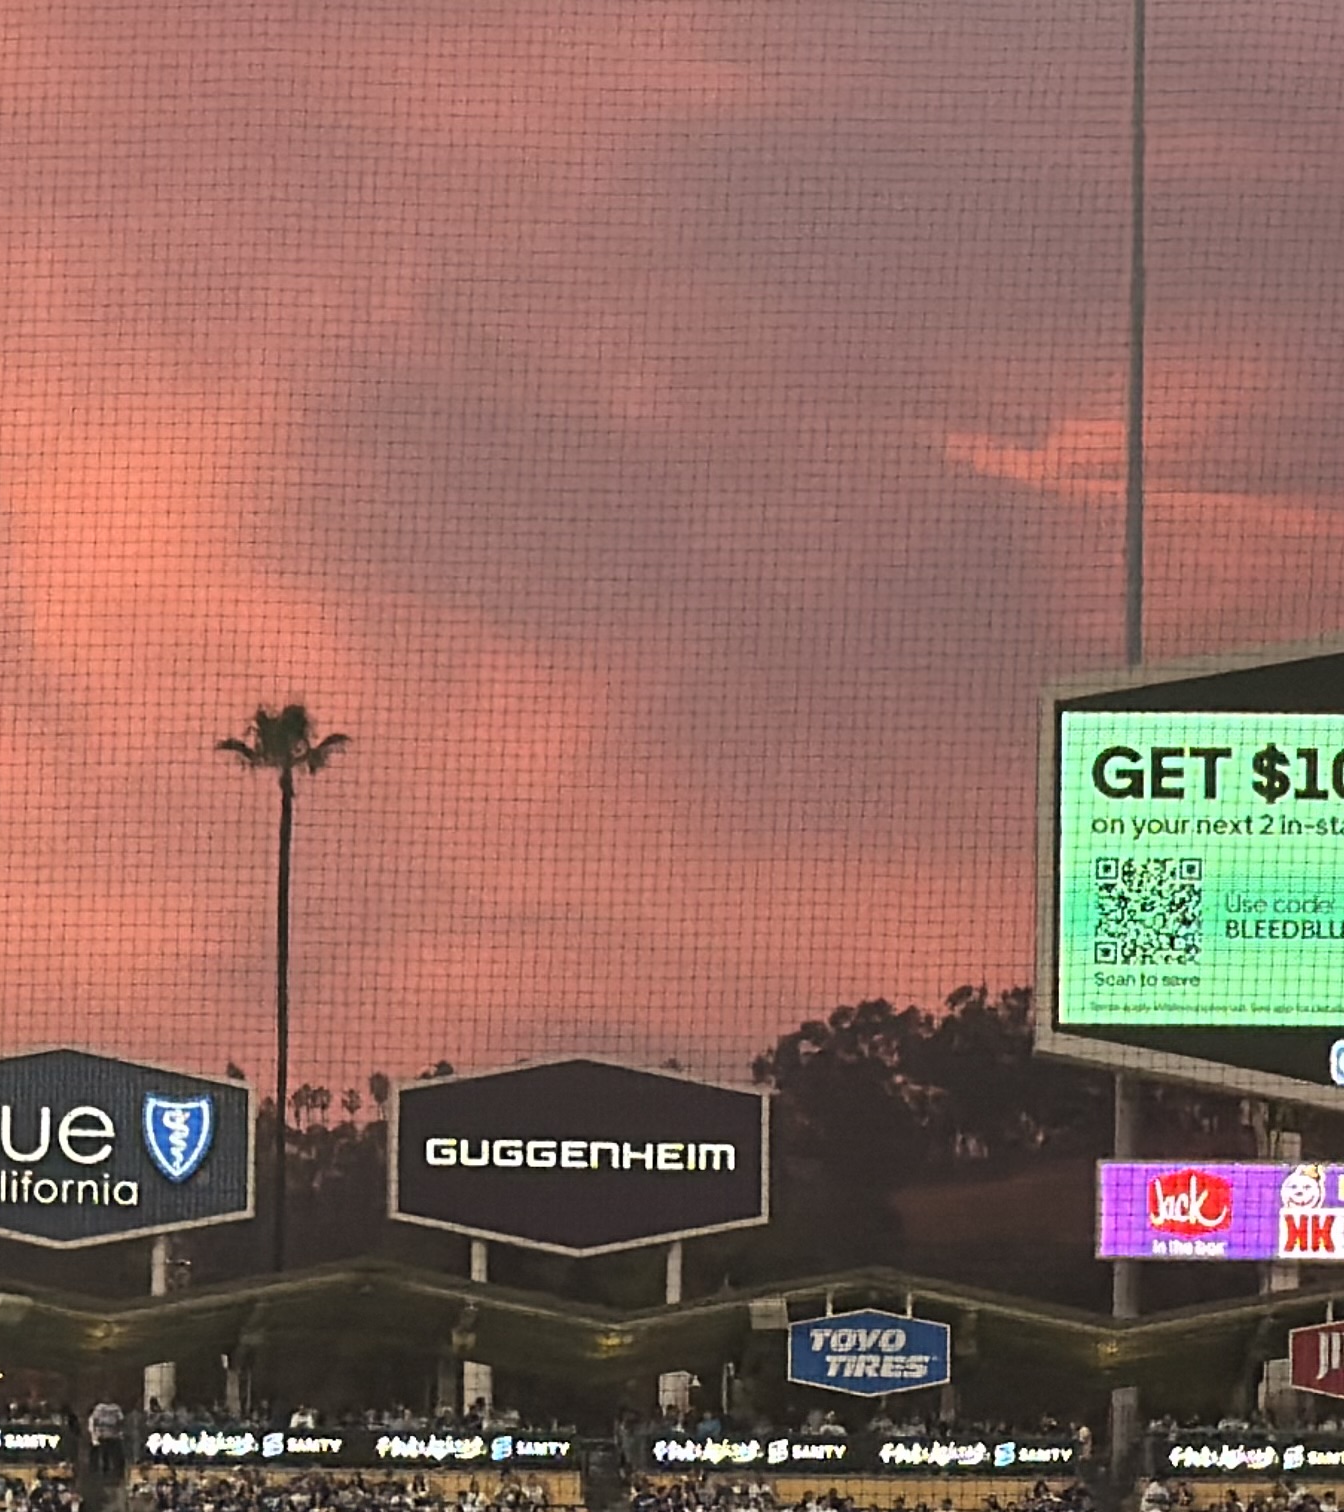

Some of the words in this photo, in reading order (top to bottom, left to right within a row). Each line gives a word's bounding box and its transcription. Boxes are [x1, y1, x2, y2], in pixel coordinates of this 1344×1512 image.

[1093, 746, 1232, 801] GET
[1092, 817, 1125, 836] on
[1132, 818, 1186, 840] your
[1197, 815, 1254, 836] next
[1259, 814, 1274, 836] 2
[1225, 894, 1266, 914] Use
[1094, 972, 1136, 987] Scan
[1141, 973, 1158, 987] to
[1163, 974, 1201, 988] save
[425, 1136, 735, 1171] GUGGENHEIM
[1150, 1173, 1228, 1227] Jack
[810, 1328, 906, 1352] TOYO
[825, 1355, 930, 1379] TIRES
